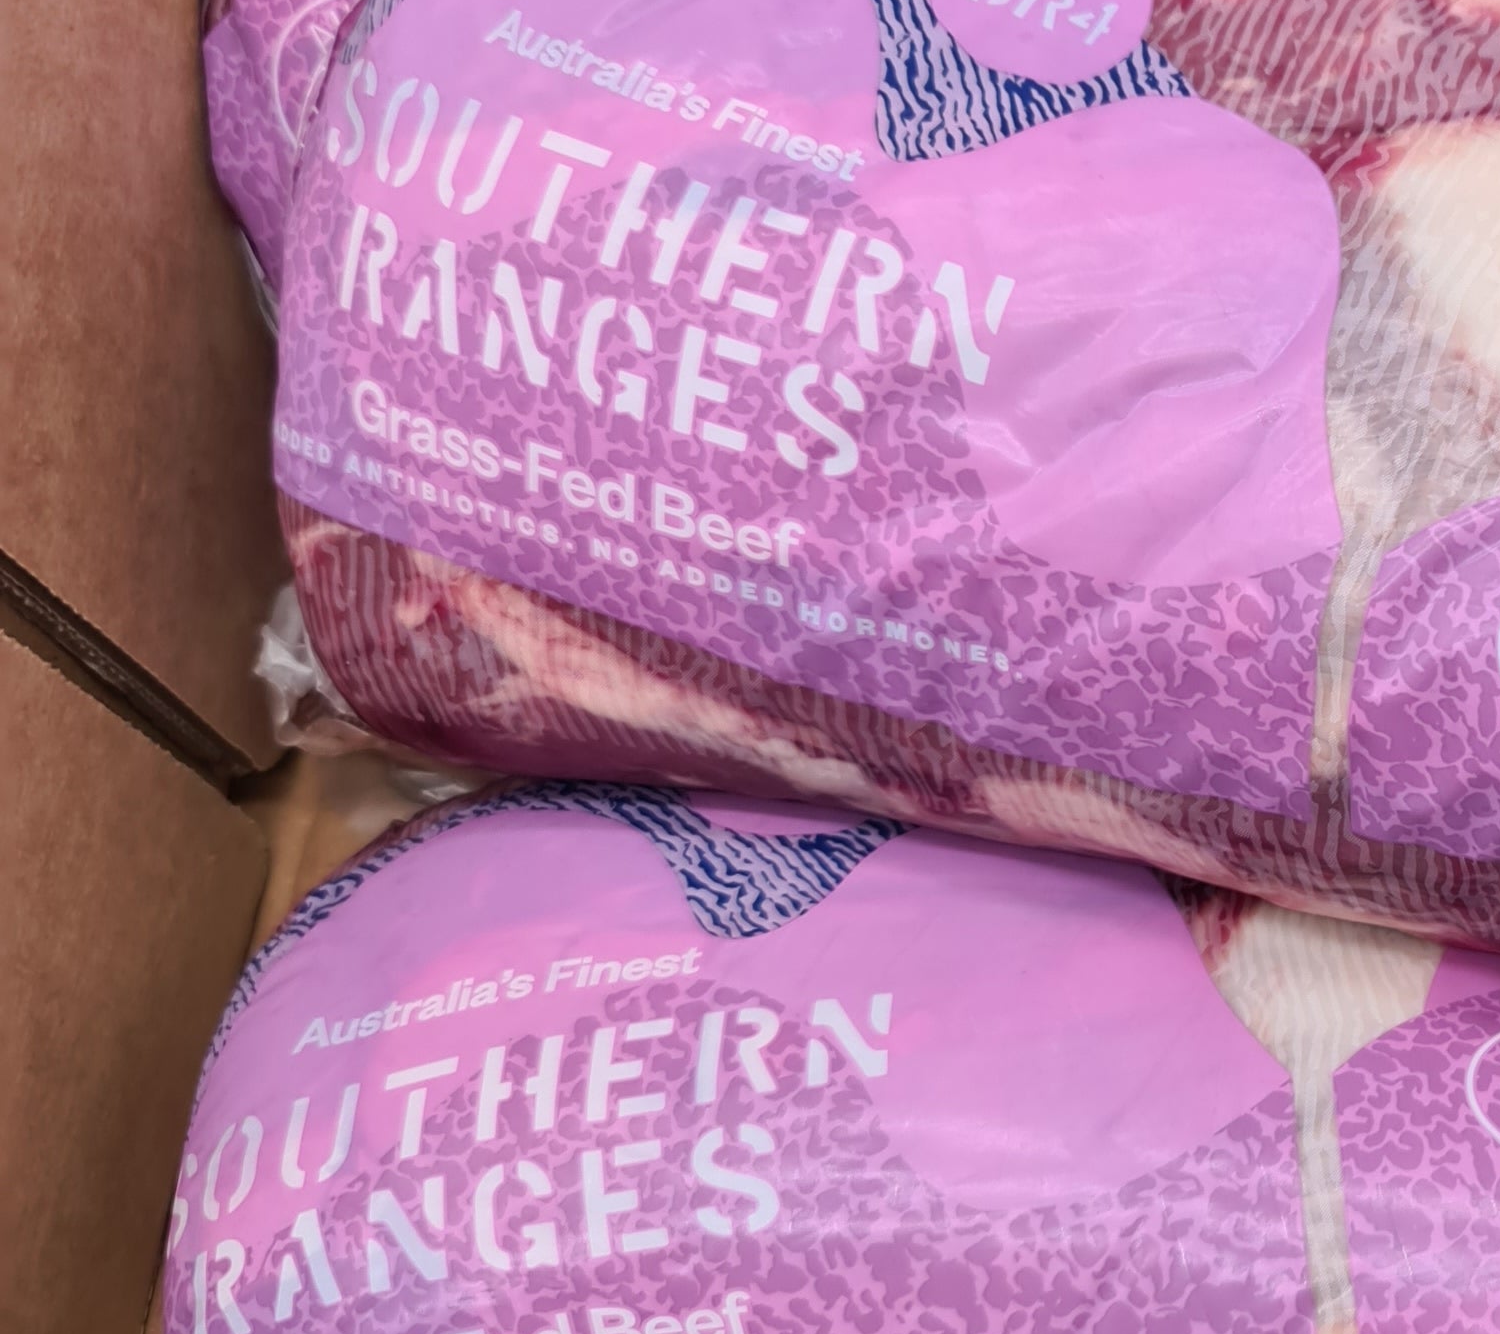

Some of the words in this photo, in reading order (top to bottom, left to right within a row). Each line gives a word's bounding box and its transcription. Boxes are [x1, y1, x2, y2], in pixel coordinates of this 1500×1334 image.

[485, 8, 711, 125] Australia's
[711, 95, 866, 182] Finest
[327, 59, 1016, 386] SOUTHERN
[338, 204, 866, 477] RANGES
[343, 454, 574, 551] ANTIBIOTICS.
[590, 537, 640, 568] NO
[658, 558, 785, 608] ADDED
[800, 602, 1024, 681] HORMONES.
[350, 379, 637, 525] Grass-Fed
[647, 482, 806, 569] Beef
[291, 967, 535, 1056] Australia's
[542, 946, 703, 993] Finest
